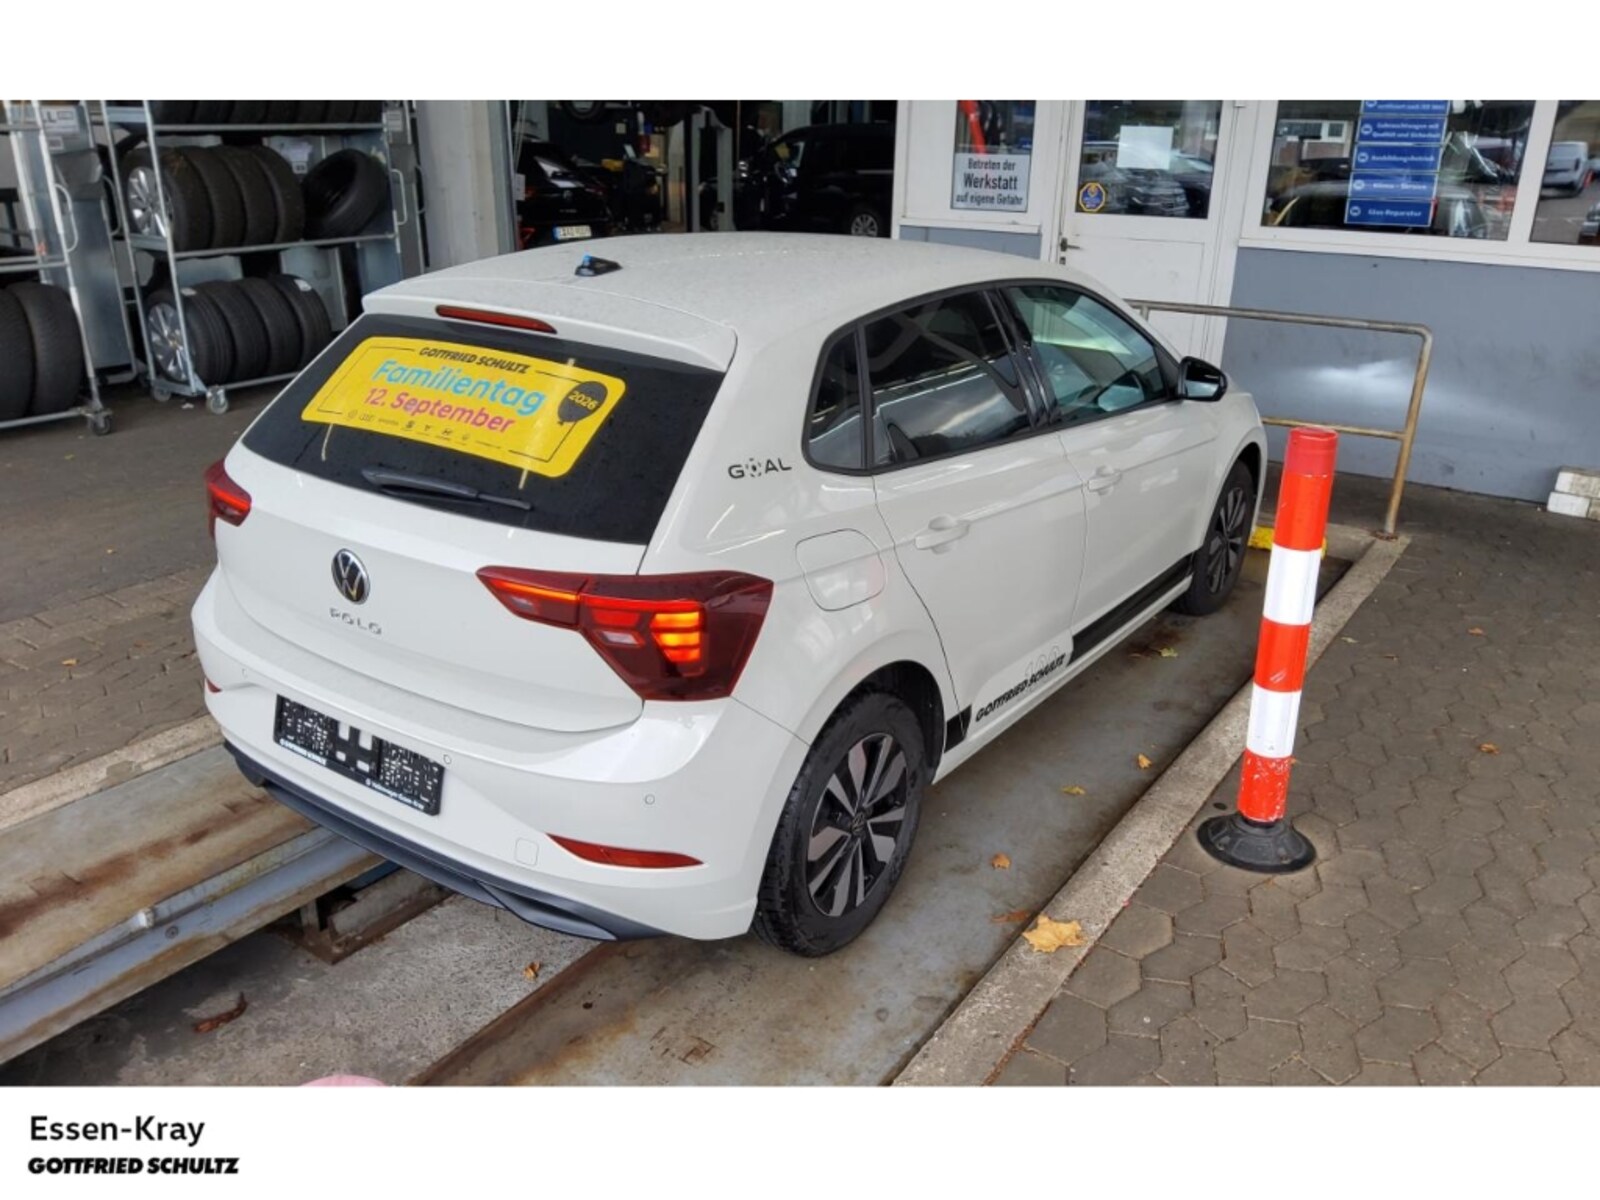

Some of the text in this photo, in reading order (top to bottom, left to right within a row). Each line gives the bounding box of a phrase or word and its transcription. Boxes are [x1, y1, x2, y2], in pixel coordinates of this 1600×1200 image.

[968, 158, 1016, 171] Betreten der
[963, 173, 1018, 190] Werkstatt
[956, 192, 1023, 206] auf eigene Gefahr
[418, 346, 531, 375] GOTTFRIED SCHULTZ
[372, 360, 546, 417] Familientag
[567, 389, 599, 411] 2026
[364, 387, 515, 433] 12. September
[975, 653, 1066, 722] GOTTFRIED SCHULTZ
